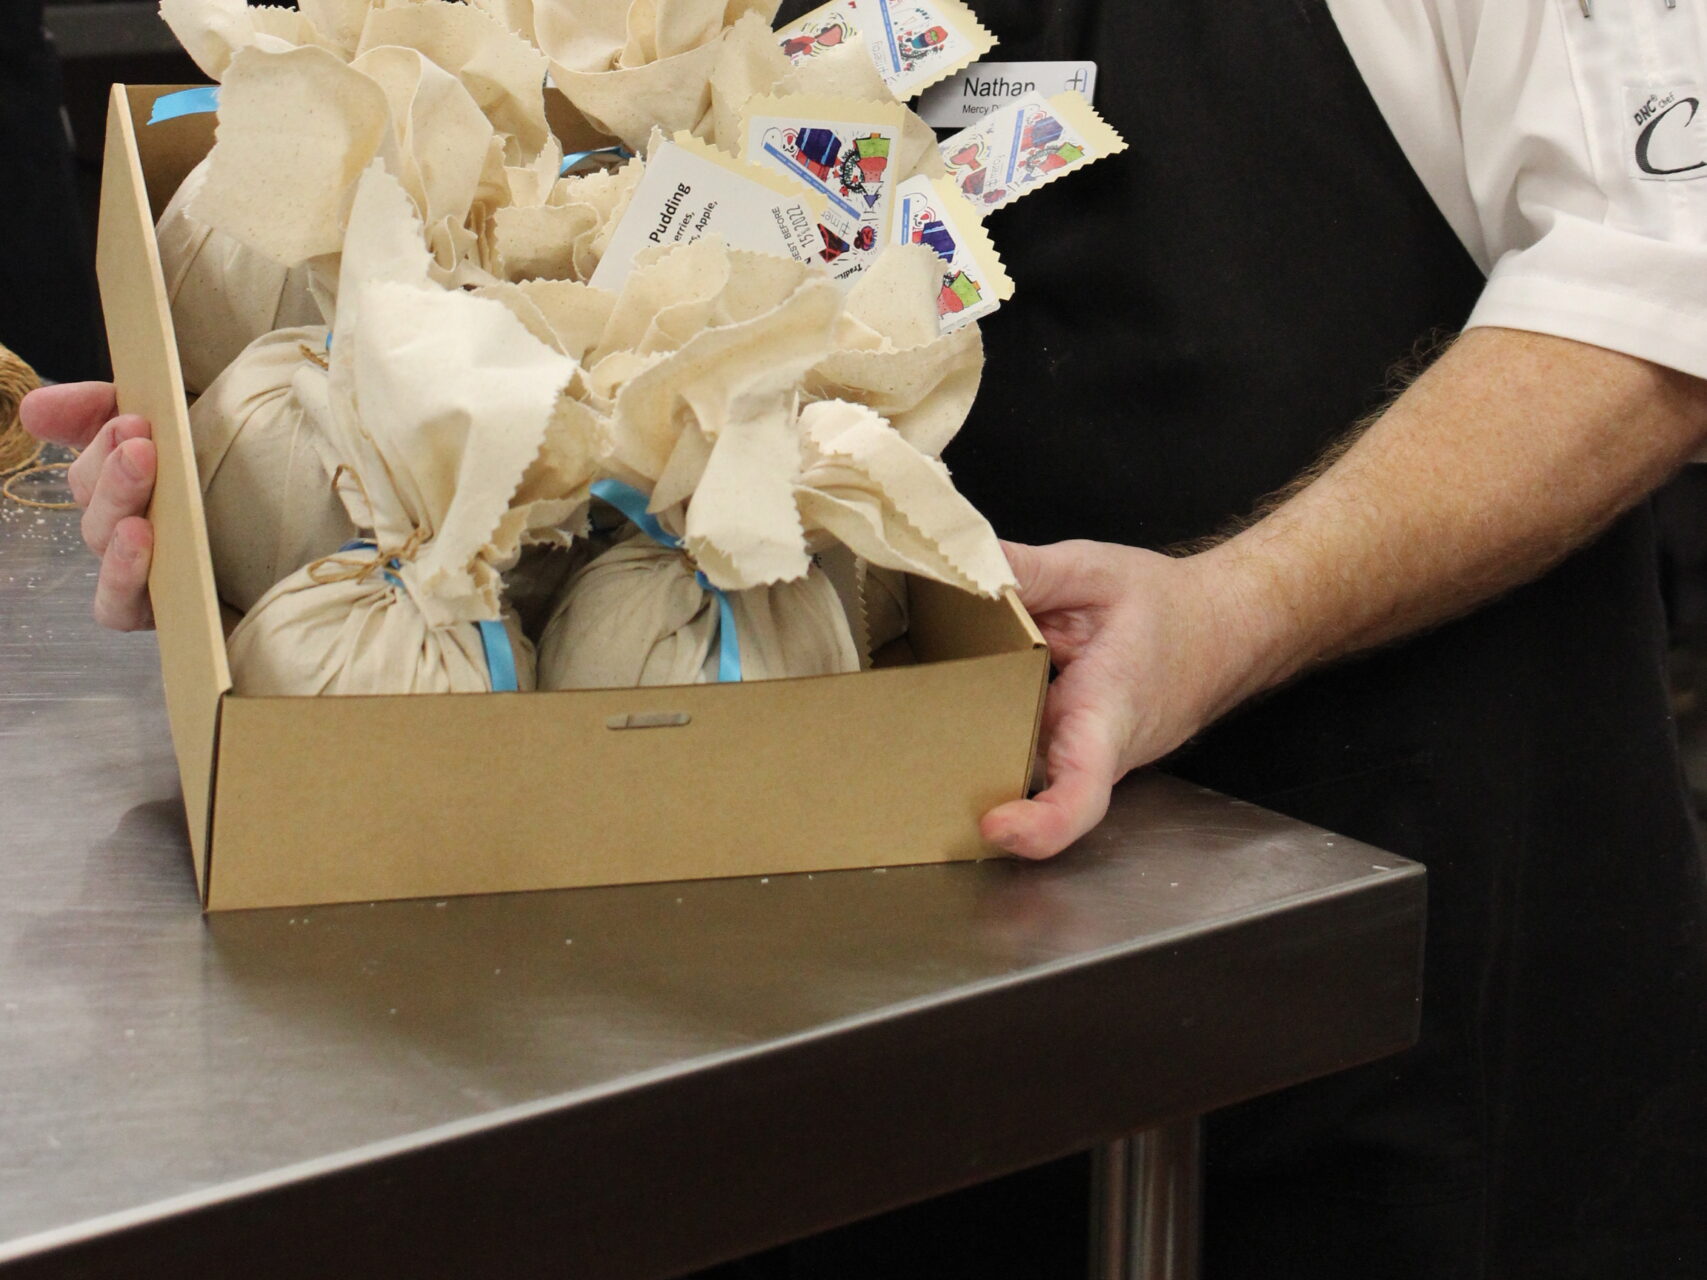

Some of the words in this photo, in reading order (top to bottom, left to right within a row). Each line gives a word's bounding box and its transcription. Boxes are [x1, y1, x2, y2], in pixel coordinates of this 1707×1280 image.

[963, 77, 1035, 97] Nathan
[962, 104, 989, 115] Mercy
[649, 182, 691, 243] Pudding
[695, 201, 718, 232] Apple,
[771, 206, 791, 240] BEFORE
